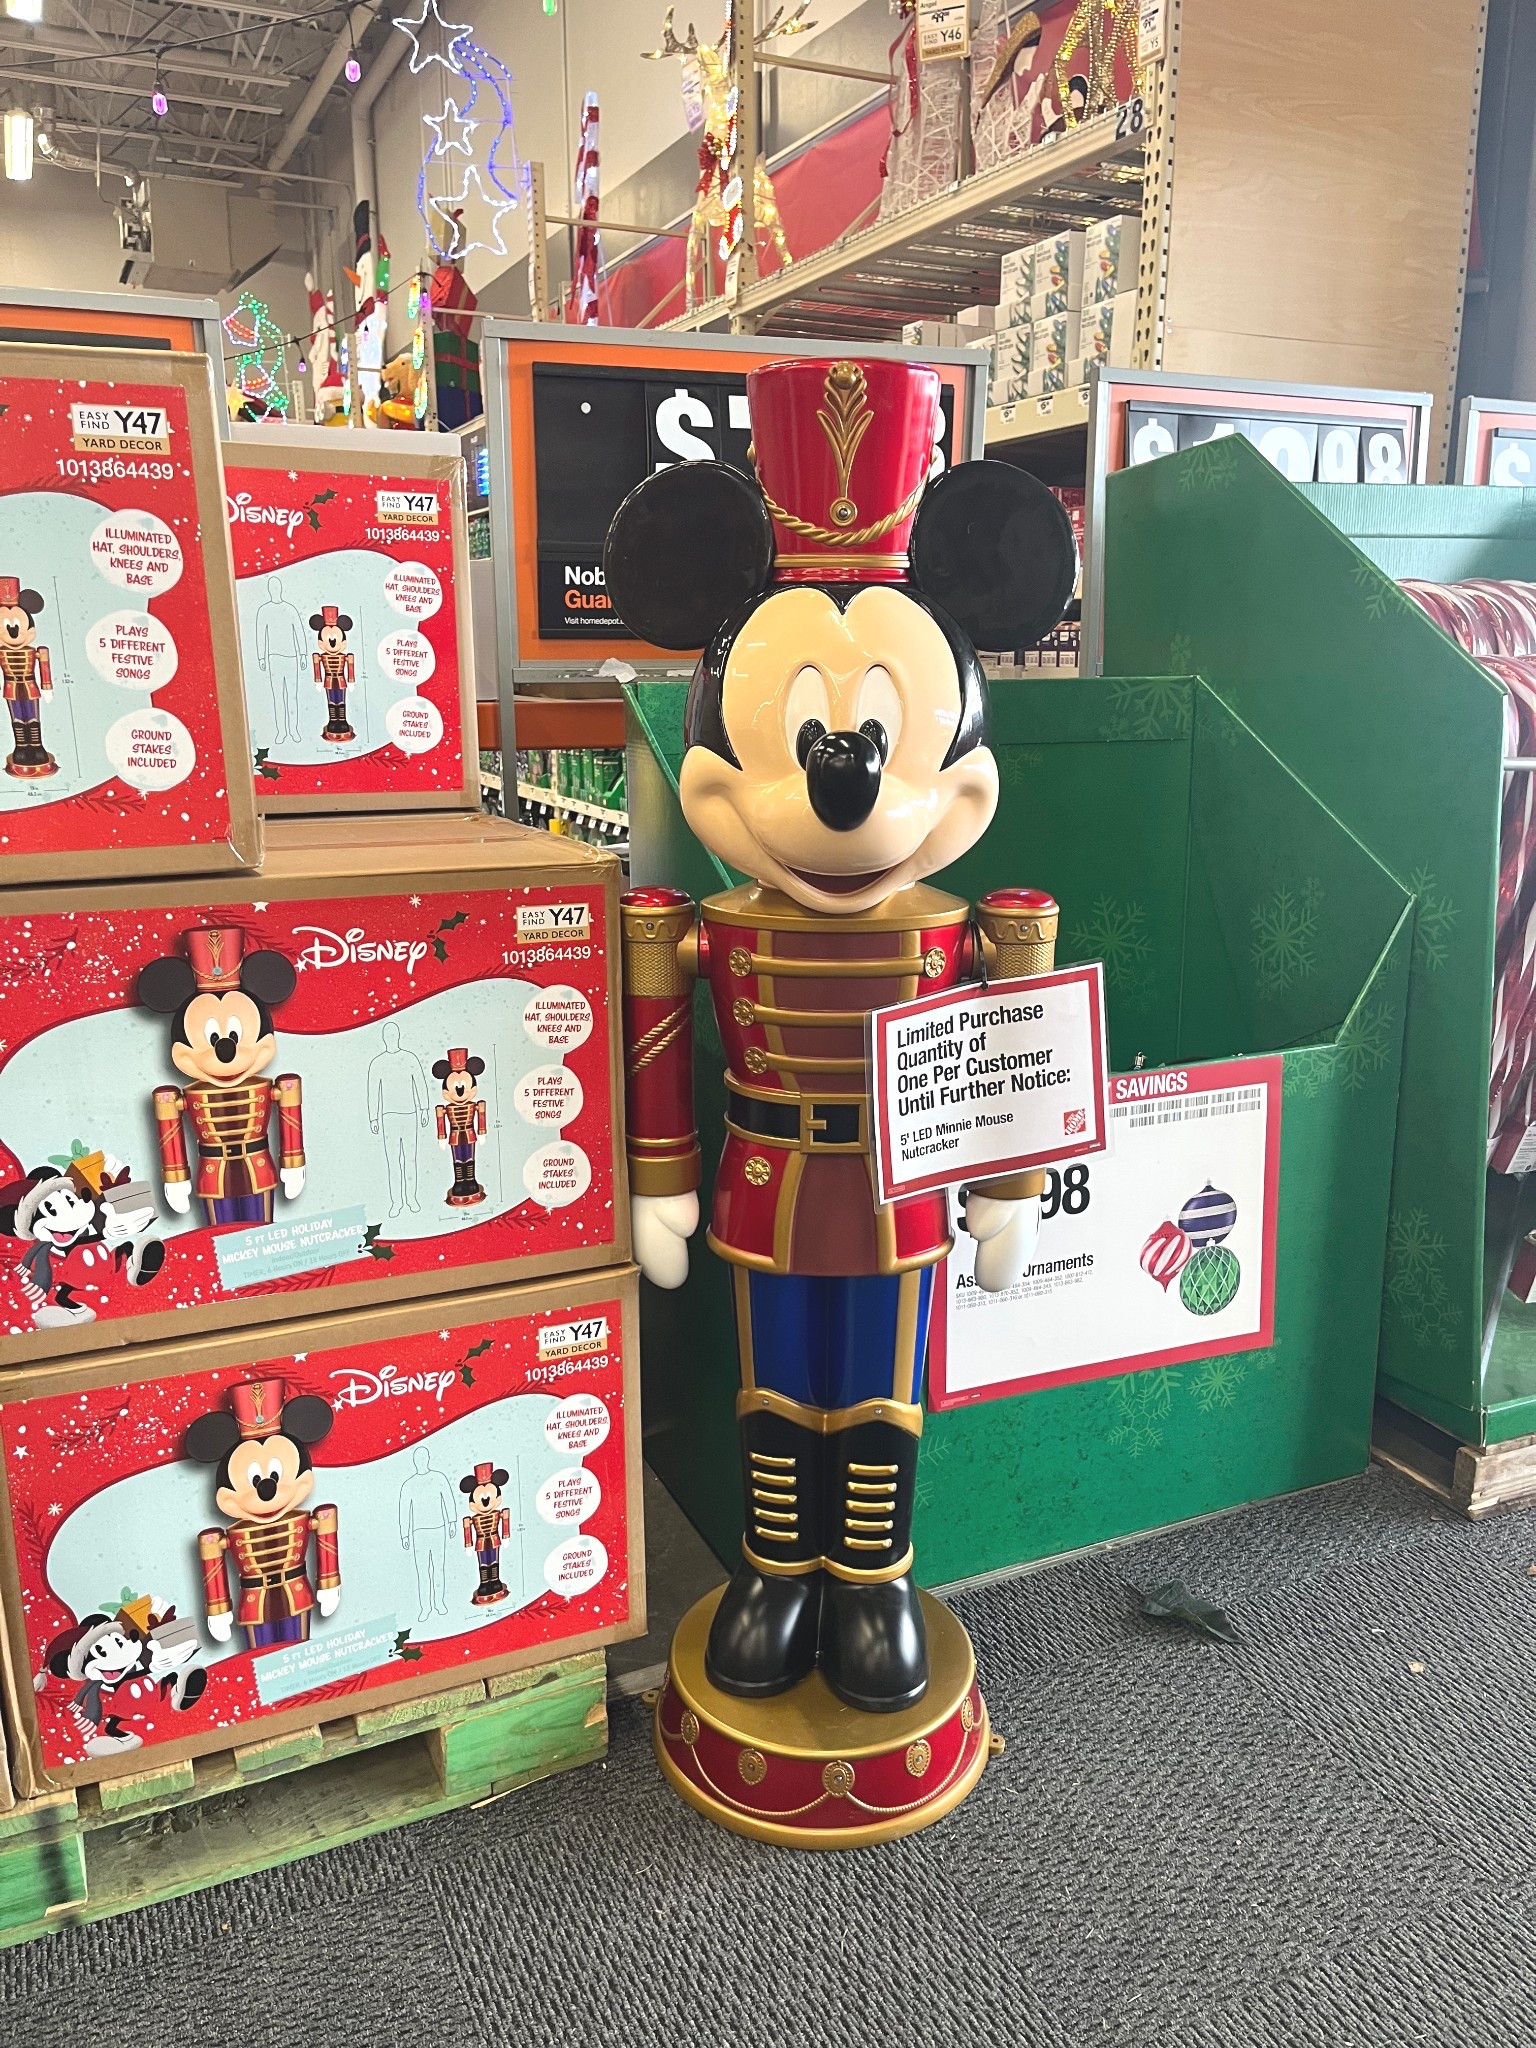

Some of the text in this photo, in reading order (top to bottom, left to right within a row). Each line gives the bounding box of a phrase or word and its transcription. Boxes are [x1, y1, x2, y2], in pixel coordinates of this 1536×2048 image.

[940, 27, 962, 42] Y46
[1115, 99, 1143, 141] 28
[79, 411, 109, 420] EASY
[80, 421, 110, 430] FIND
[113, 410, 161, 435] Y47
[82, 438, 163, 451] YARD DECOR
[56, 459, 174, 480] 1013864439
[404, 495, 434, 512] Y47
[406, 514, 434, 523] DECOR
[106, 528, 171, 544] ILLUMINATED
[365, 528, 439, 542] 1013864439
[93, 542, 180, 561] HAT, SHOULDERS,
[110, 557, 168, 572] KNEES AND
[126, 574, 153, 585] BASE
[394, 574, 436, 585] ILLUMINATED
[565, 566, 606, 585] Nob
[396, 594, 433, 604] KNEES AND
[406, 605, 422, 613] BASE
[116, 625, 148, 637] PLAYS
[99, 638, 165, 653] 5 DIFFERENT
[397, 639, 418, 648] PLAYS
[112, 653, 154, 665] FESTIVE
[393, 649, 428, 658] DIFFERENT
[393, 658, 419, 667] FESTIVE
[116, 668, 150, 679] SONGS
[396, 668, 417, 677] SONGS
[403, 711, 429, 719] GROUND
[403, 720, 428, 728] STAKES
[131, 729, 172, 740] GROUND
[399, 730, 431, 739] INCLUDED
[132, 744, 172, 755] STAKES
[128, 757, 177, 768] INCLUDED
[522, 911, 545, 919] EASY
[548, 907, 585, 926] Y47
[522, 918, 545, 926] FIND
[523, 929, 585, 941] YARD DECOR
[291, 925, 427, 975] Disney
[502, 947, 591, 965] 1013864439
[535, 1002, 586, 1010] ILLUMINATED
[525, 1013, 592, 1022] HAT, SHOULDERS,
[537, 1024, 562, 1032] KNEES
[897, 1004, 1044, 1048] Limited Purchase
[548, 1036, 569, 1044] BASE
[897, 1032, 987, 1071] Quantity of
[898, 1048, 1053, 1093] One Per Customer
[537, 1077, 562, 1085] PLAYS
[1116, 1072, 1188, 1100] SAVINGS
[533, 1088, 575, 1096] DIFFERENT
[898, 1068, 1071, 1116] Until Further Notice:
[533, 1099, 564, 1107] FESTIVE
[535, 1110, 562, 1119] SONGS
[1065, 1108, 1085, 1135] HOME
[900, 1112, 1014, 1146] 5' LED Minnie Mouse
[902, 1138, 960, 1161] Nutcracker
[543, 1158, 575, 1167] GROUND
[543, 1169, 574, 1178] STAKES
[539, 1180, 577, 1189] INCLUDED
[246, 1237, 252, 1246] 5
[268, 1228, 288, 1241] LED
[291, 1218, 333, 1237] HOLIDAY
[222, 1224, 365, 1264] MICKEY MOUSE NUTCRACKER
[544, 1329, 566, 1338] EASY
[569, 1320, 603, 1341] Y47
[544, 1335, 566, 1345] FIND
[545, 1341, 602, 1358] YARD DECOR
[524, 1356, 608, 1382] 1013864439
[329, 1365, 455, 1402] Disney
[556, 1407, 603, 1419] ILLUMINATED
[546, 1417, 609, 1431] HAT, SHOULDERS,
[558, 1428, 599, 1440] KNEES AND
[569, 1440, 587, 1449] BASE
[559, 1478, 581, 1488] PLAYS
[546, 1487, 592, 1500] 5 DIFFERENT
[554, 1498, 583, 1509] FESTIVE
[556, 1509, 580, 1518] SONGS
[563, 1550, 592, 1561] GROUND
[563, 1560, 591, 1570] STAKES
[558, 1569, 594, 1581] INCLUDED
[283, 1655, 289, 1663] 5
[305, 1643, 323, 1656] LED
[326, 1629, 366, 1648] HOLIDAY
[261, 1664, 296, 1682] MICKEY
[297, 1653, 332, 1670] MOUSE
[334, 1632, 394, 1657] NUTCRACKER
